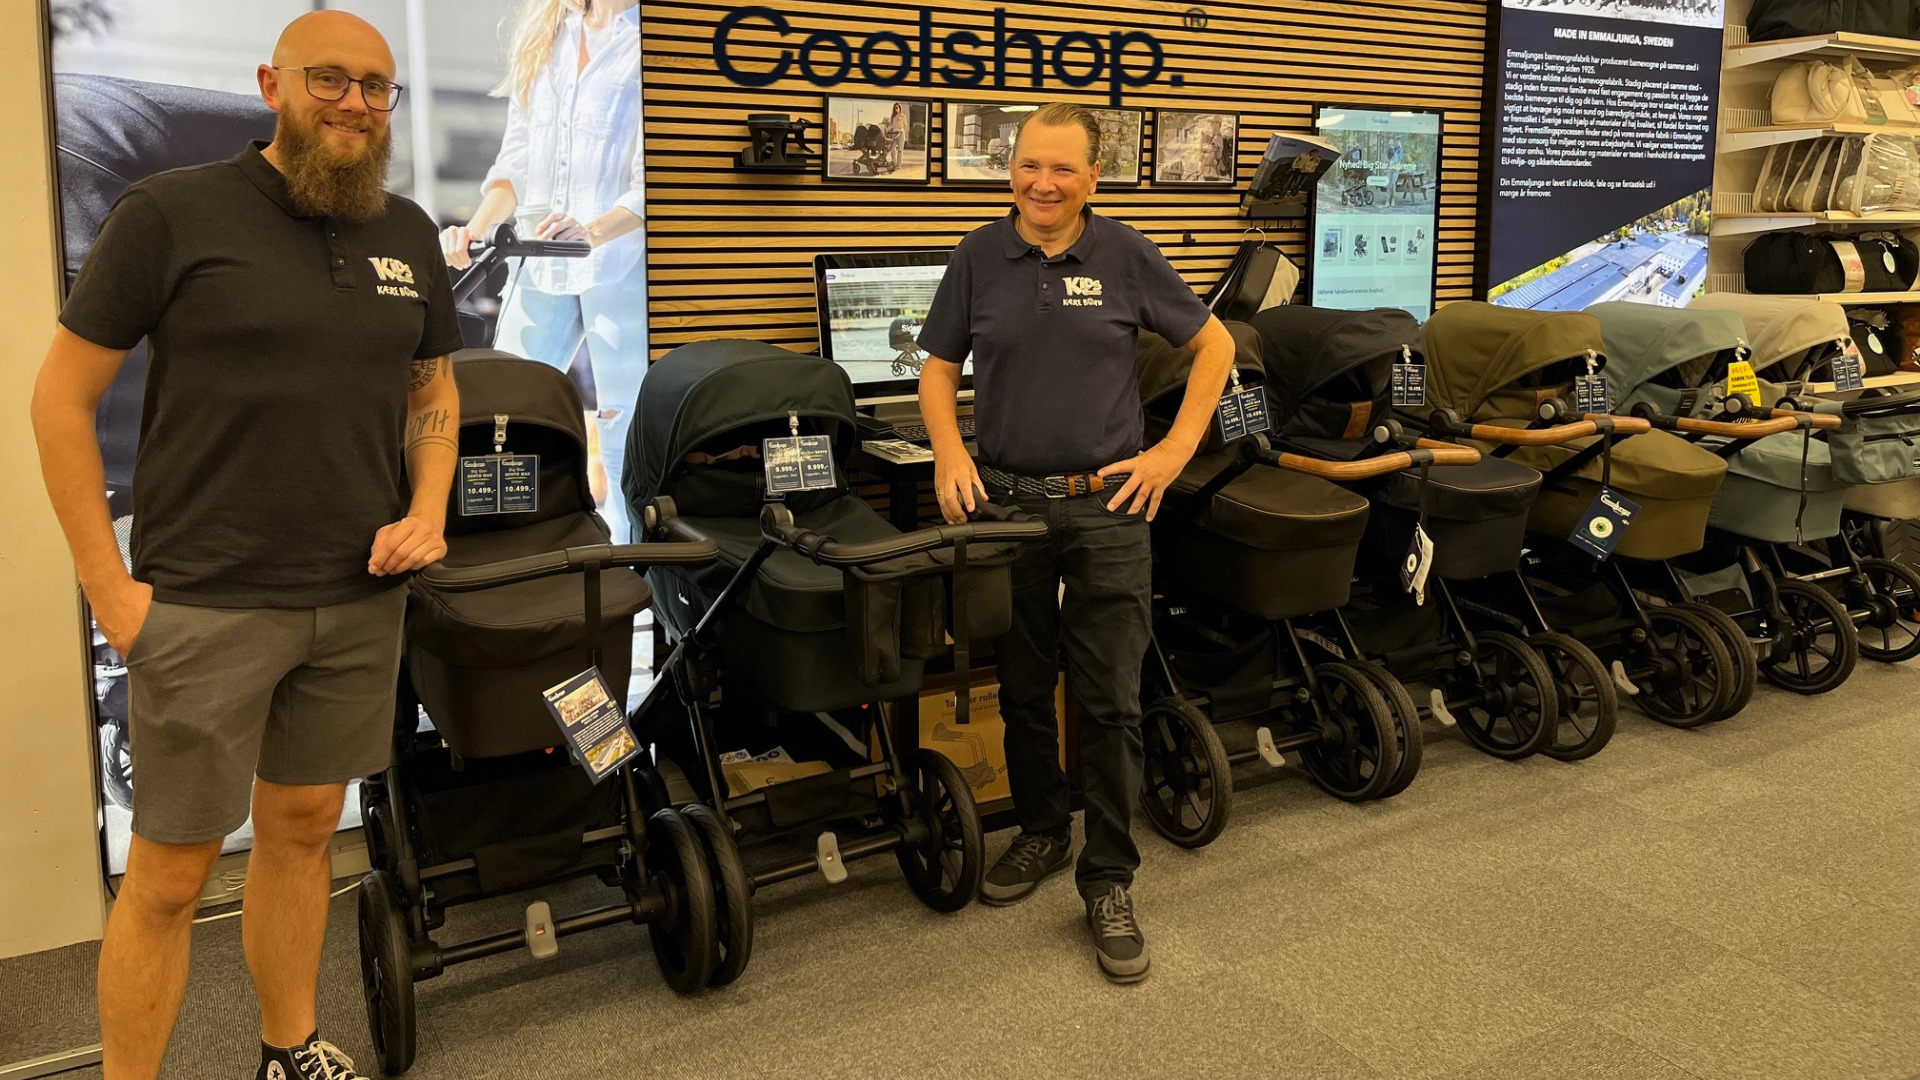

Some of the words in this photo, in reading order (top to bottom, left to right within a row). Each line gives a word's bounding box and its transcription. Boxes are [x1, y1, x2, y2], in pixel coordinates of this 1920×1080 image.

[1554, 29, 1577, 39] MADE
[1578, 31, 1587, 40] IN
[1588, 31, 1642, 46] EMMALJUNGA,
[1642, 36, 1674, 47] SWEDEN
[504, 485, 535, 493] 10.499,-
